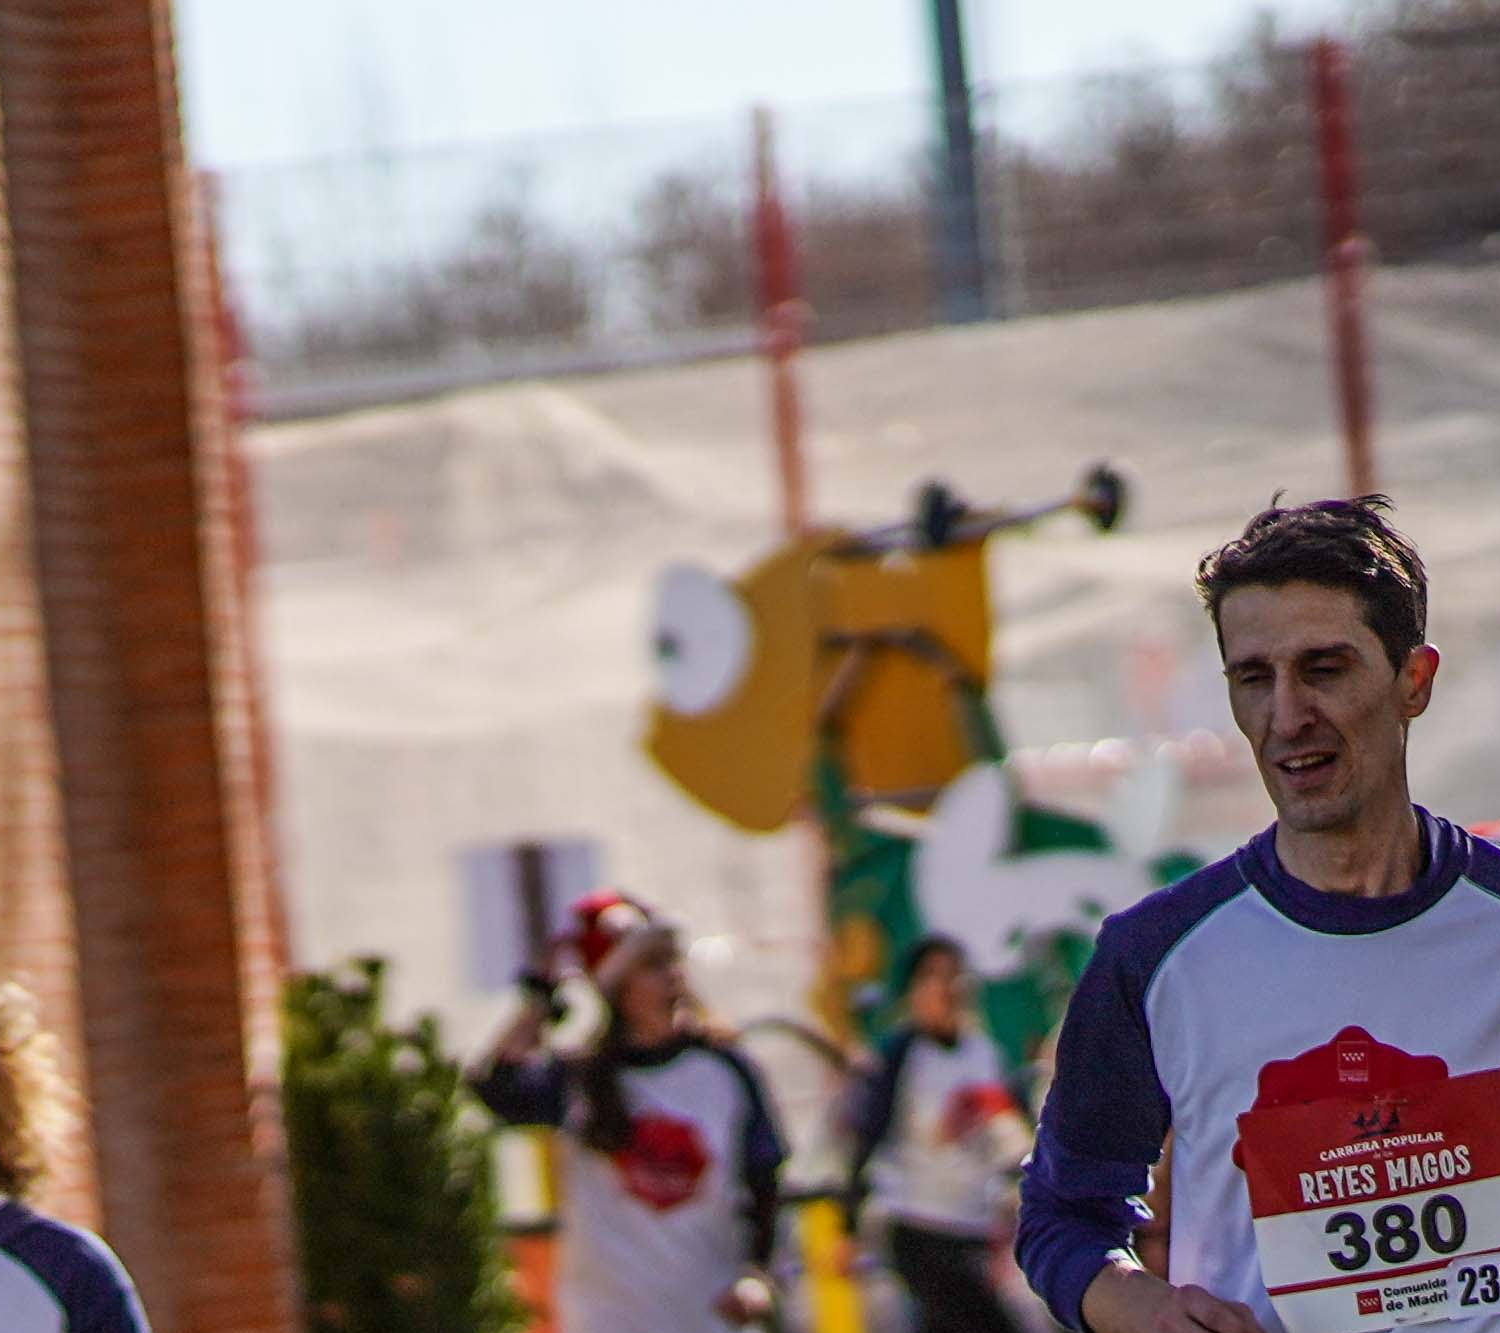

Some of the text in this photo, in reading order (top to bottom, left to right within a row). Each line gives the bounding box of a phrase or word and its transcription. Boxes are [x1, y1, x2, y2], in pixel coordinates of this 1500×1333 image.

[1319, 1131, 1444, 1162] CARRERA POPULAR
[1299, 1144, 1471, 1205] REYES MAGOS
[1325, 1193, 1467, 1271] 380
[1383, 1277, 1448, 1298] Comunida
[1385, 1289, 1449, 1312] de Madri
